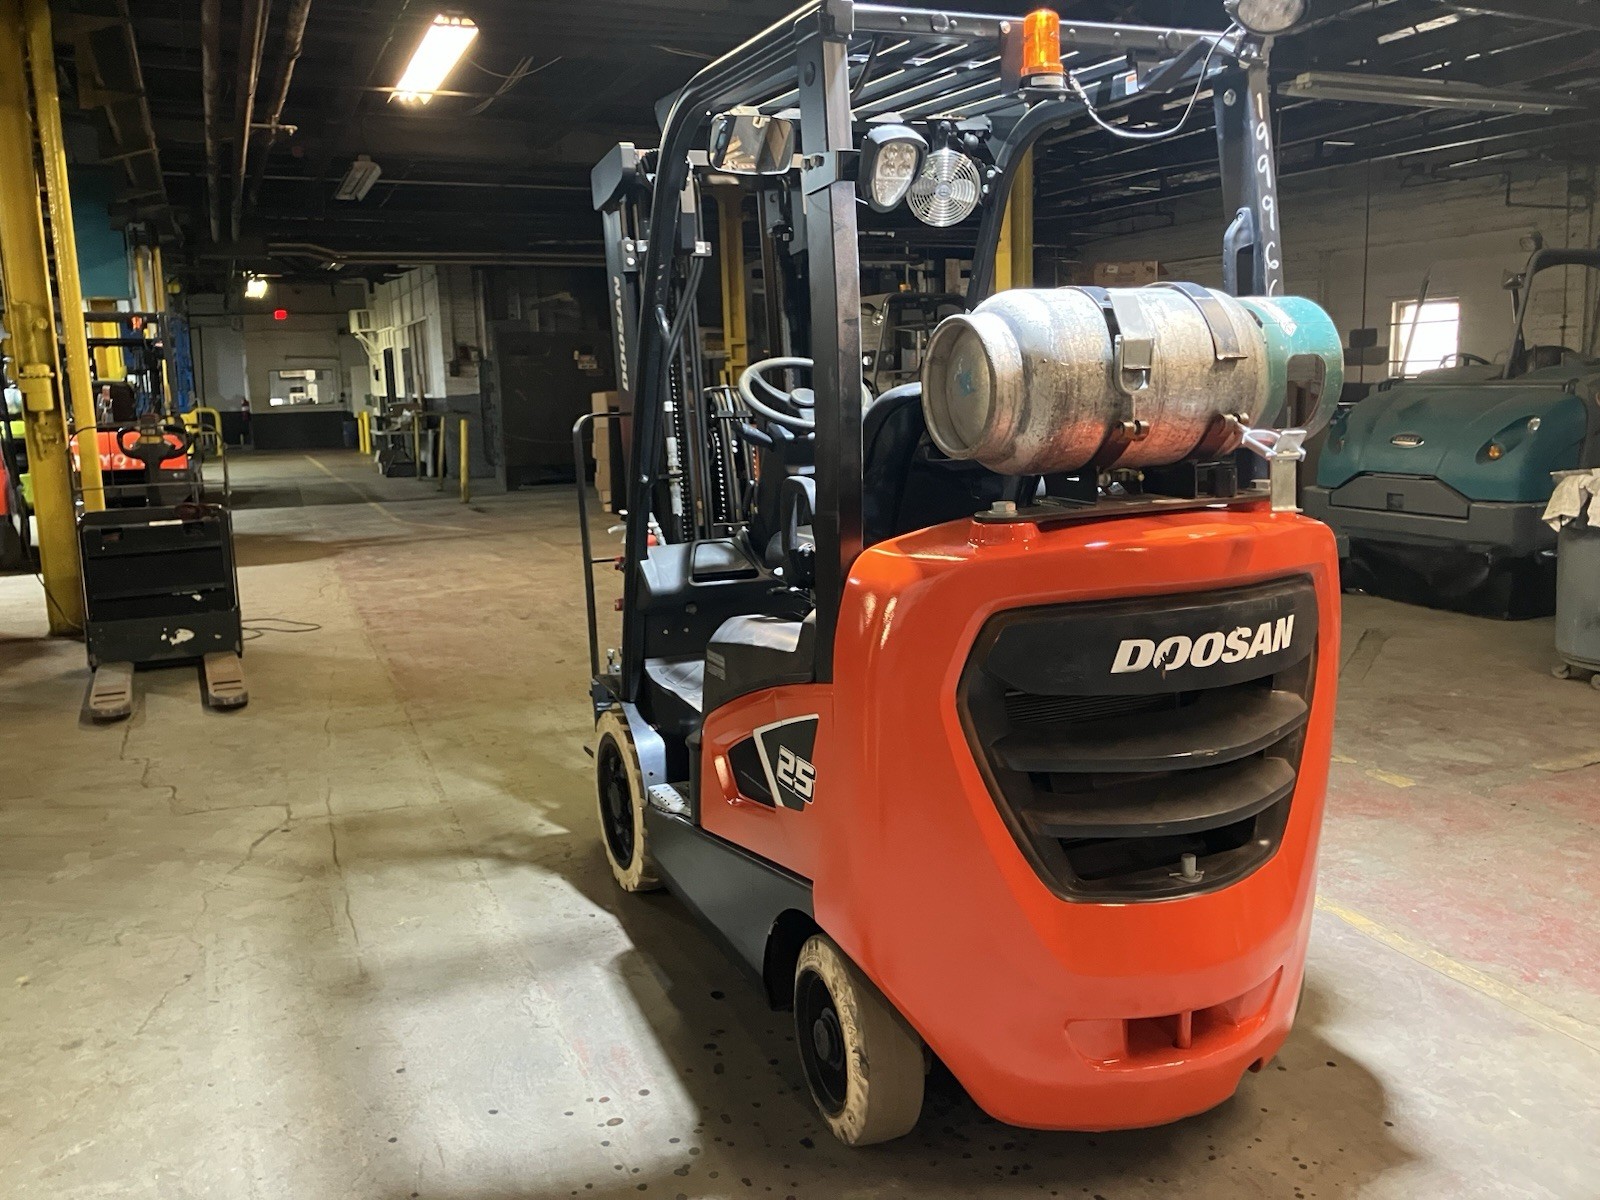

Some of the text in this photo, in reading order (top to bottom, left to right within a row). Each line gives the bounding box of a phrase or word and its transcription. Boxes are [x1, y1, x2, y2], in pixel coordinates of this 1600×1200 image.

[613, 276, 629, 392] DOOSAN
[1110, 614, 1295, 674] DOOSAN
[777, 744, 817, 805] 25
